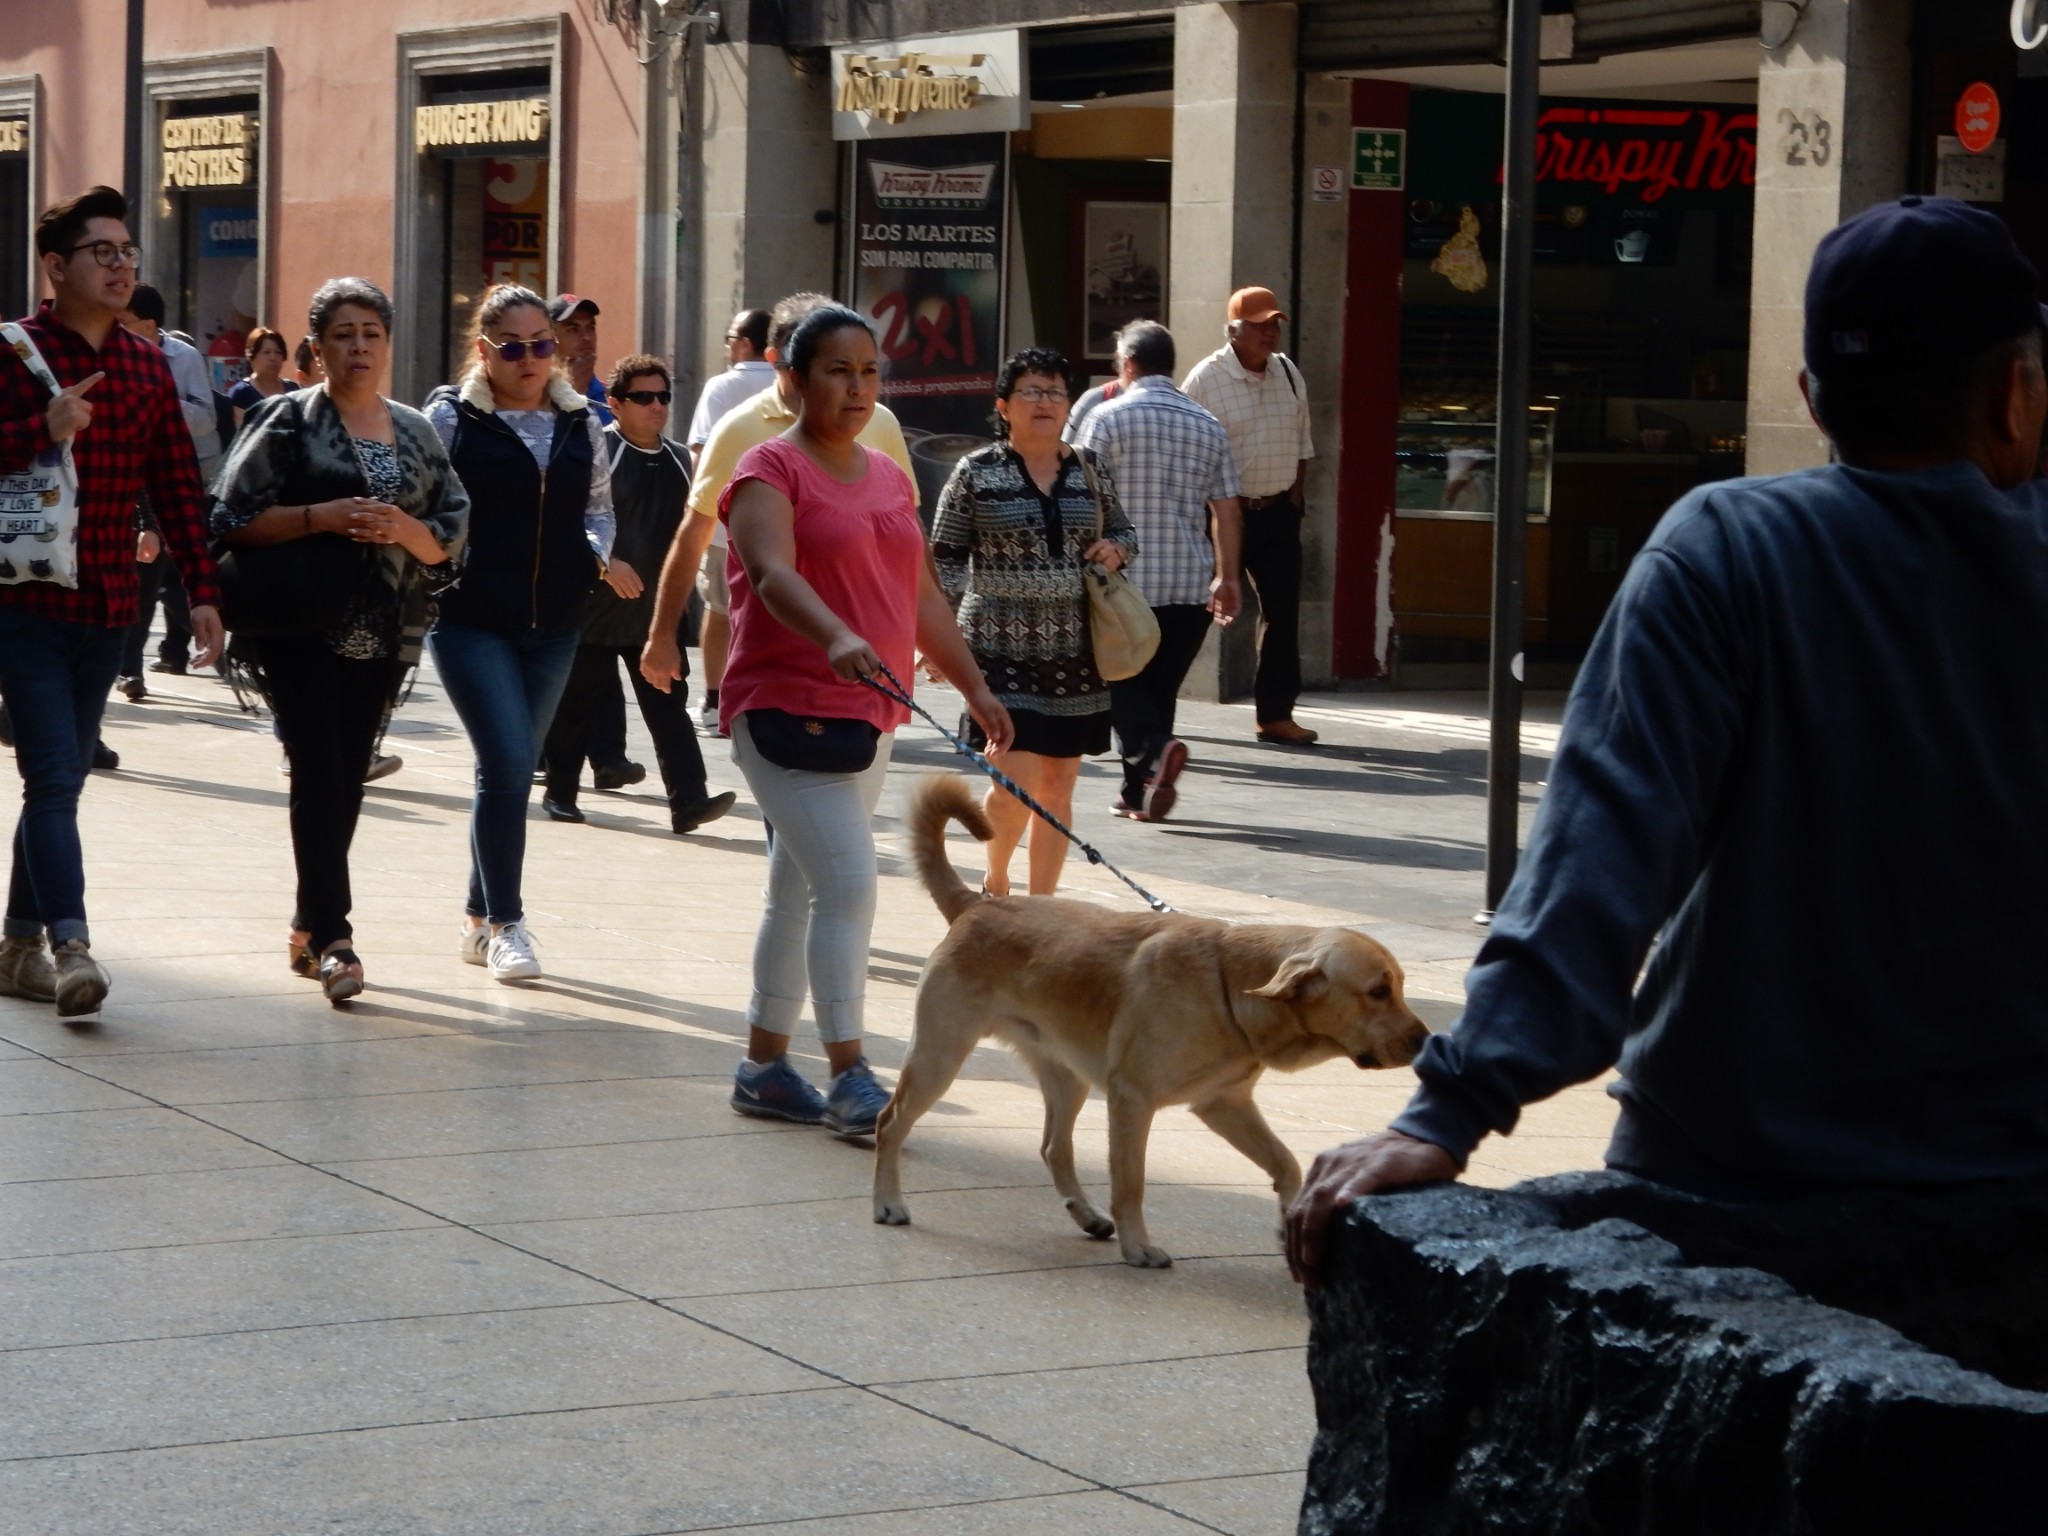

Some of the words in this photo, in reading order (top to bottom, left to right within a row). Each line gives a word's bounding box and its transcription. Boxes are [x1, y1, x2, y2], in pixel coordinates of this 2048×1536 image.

[164, 116, 222, 149] CENTRO
[223, 114, 246, 144] DE
[416, 103, 490, 147] BURGER
[492, 99, 543, 143] KING
[1782, 109, 1832, 168] 23
[164, 148, 245, 188] POSTRES
[880, 172, 931, 197] Krispy
[931, 172, 986, 194] Kreme
[881, 198, 982, 209] DOUGHNUTS
[485, 222, 540, 249] POR
[861, 223, 902, 241] LOS
[906, 224, 997, 243] MARTES
[860, 250, 886, 268] SON
[887, 250, 921, 269] PARA
[923, 251, 995, 270] COMPARTIR
[924, 376, 993, 396] preparadas
[9, 479, 28, 491] THIS
[32, 478, 49, 490] DAY
[10, 499, 35, 510] LOVE
[7, 520, 39, 532] HEART
